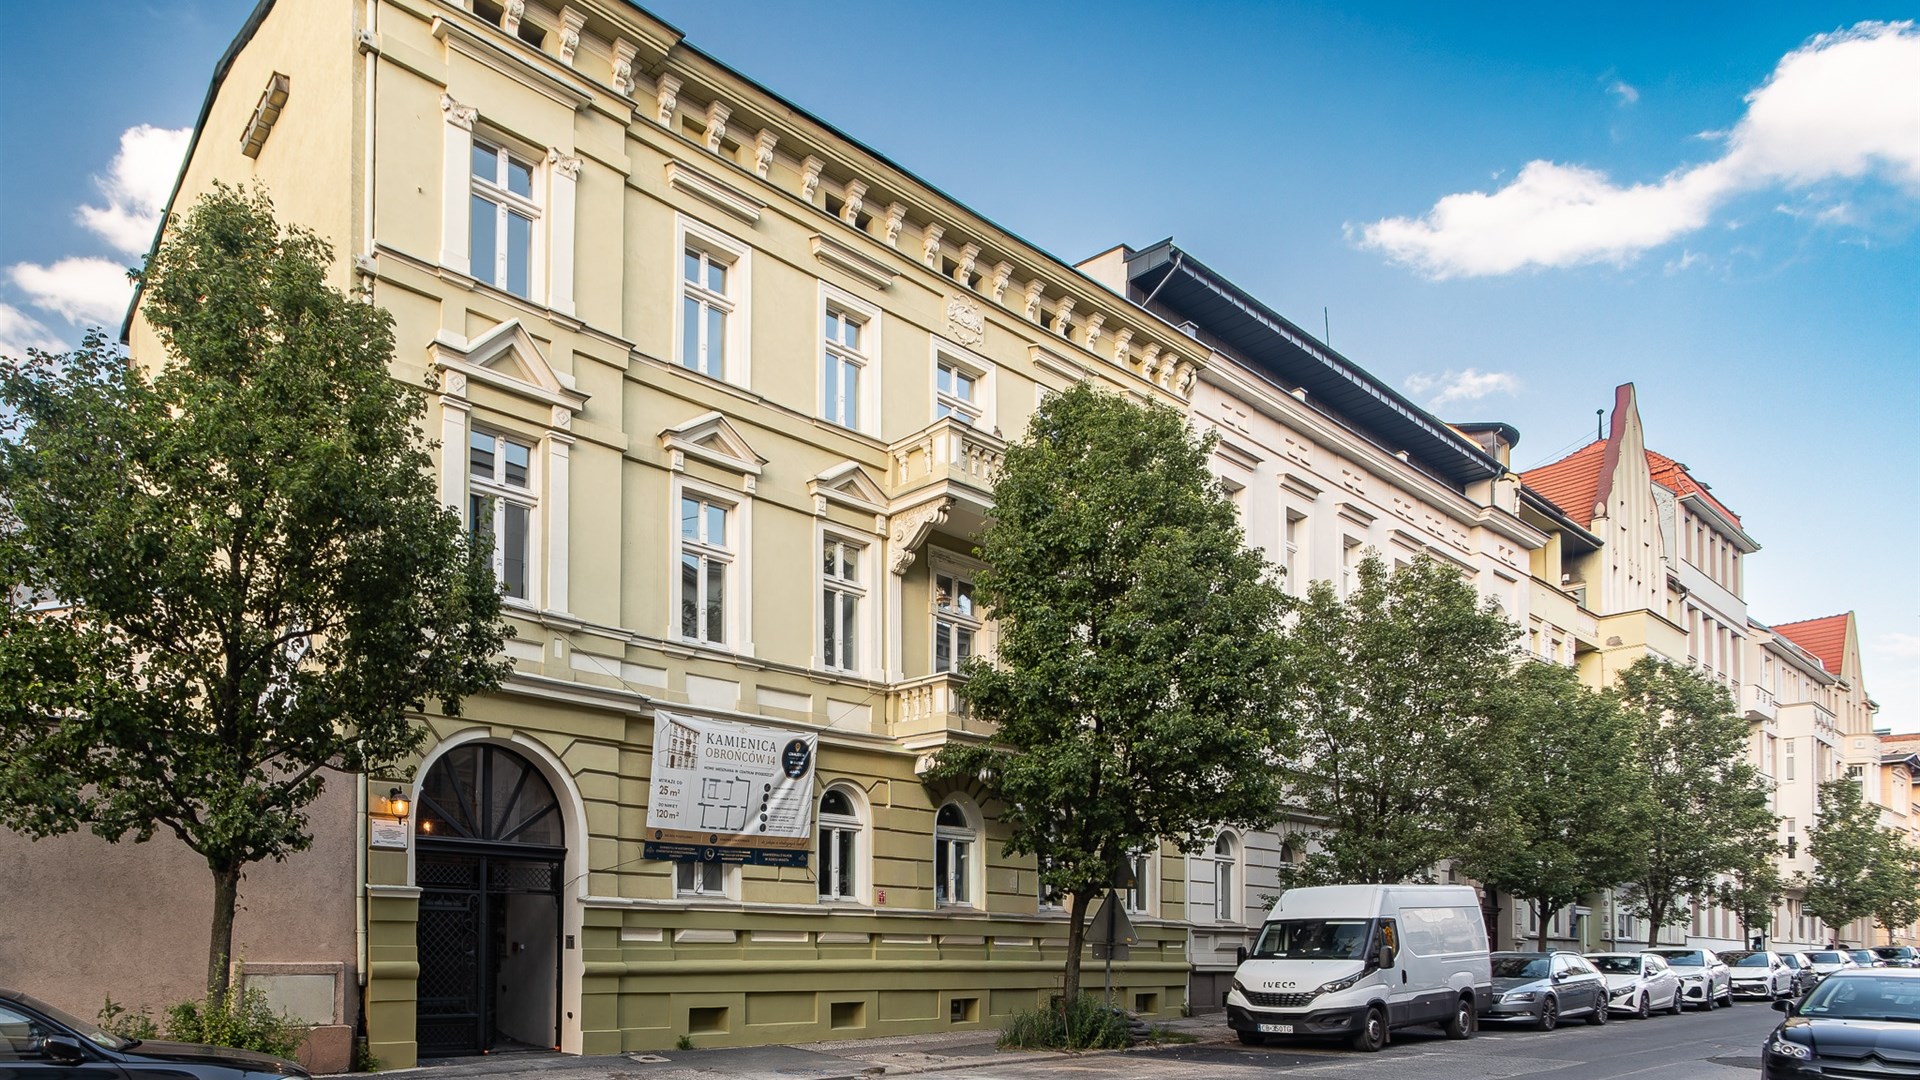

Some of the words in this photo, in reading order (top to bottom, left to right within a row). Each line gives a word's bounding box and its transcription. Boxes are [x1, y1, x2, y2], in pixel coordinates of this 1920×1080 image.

[706, 732, 776, 752] KAMIENICA
[705, 747, 766, 764] OBROŃCÓW
[767, 755, 776, 766] 14
[659, 785, 669, 796] 25
[656, 808, 669, 819] 120
